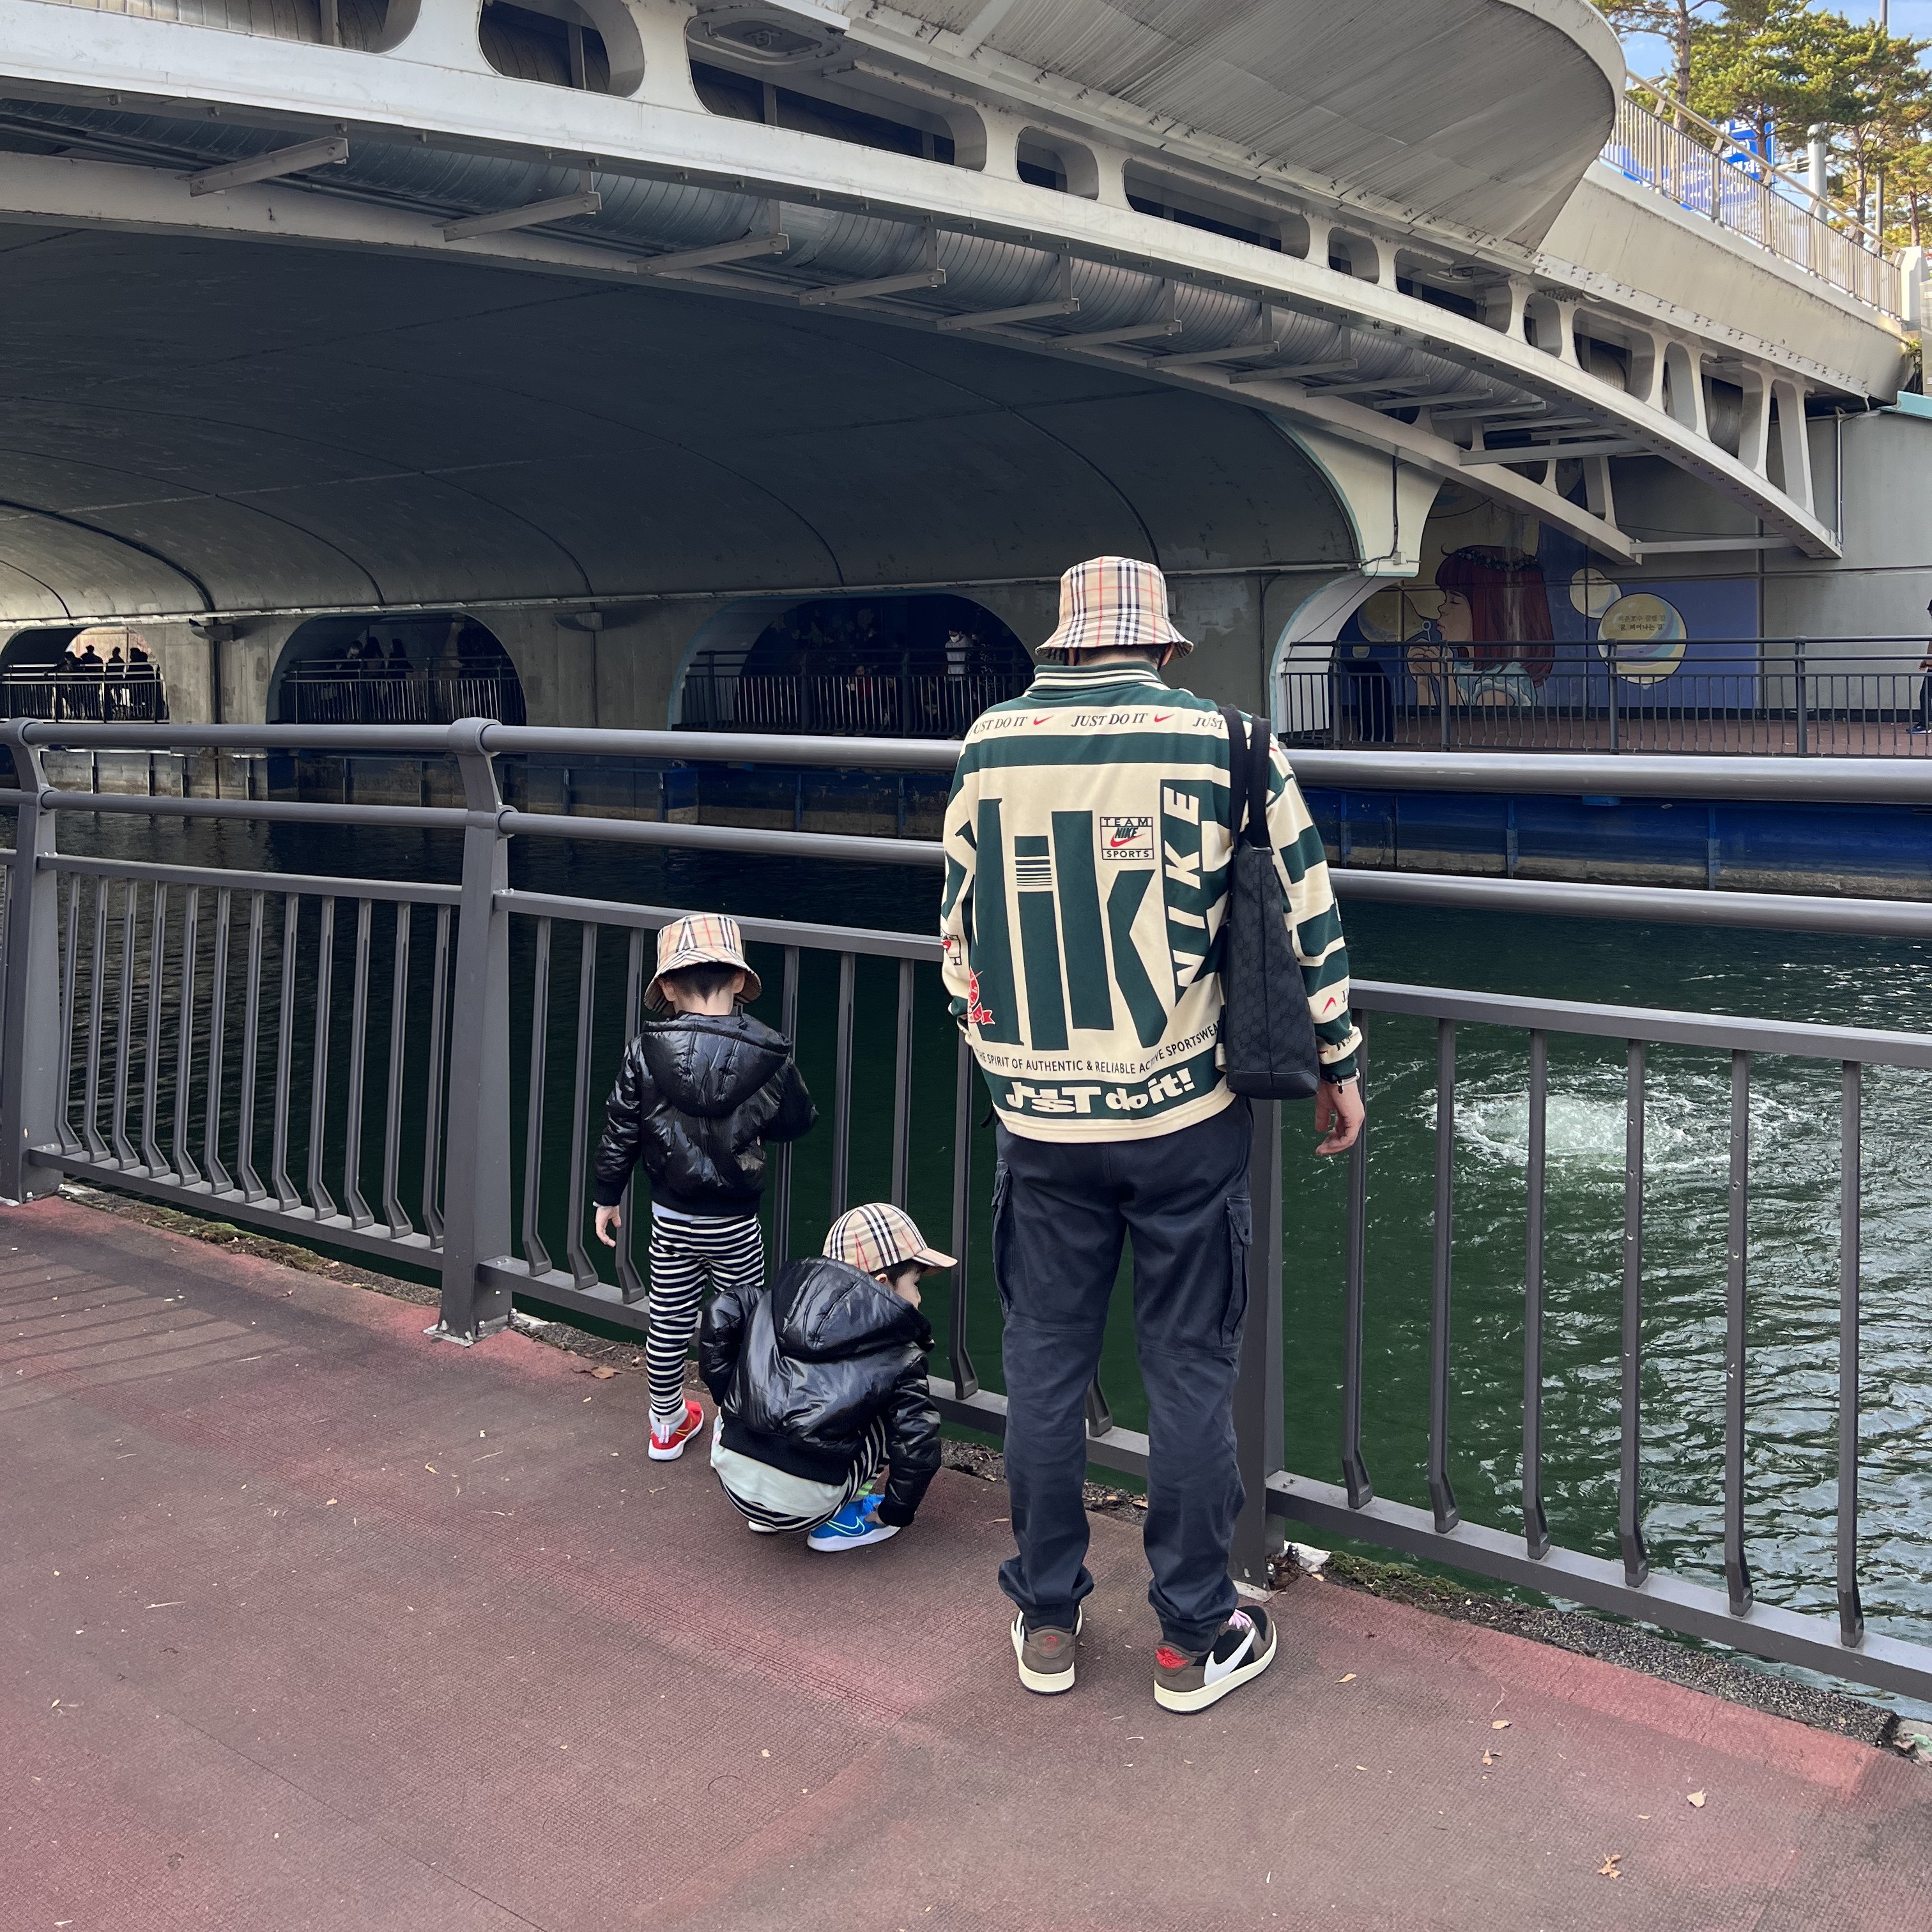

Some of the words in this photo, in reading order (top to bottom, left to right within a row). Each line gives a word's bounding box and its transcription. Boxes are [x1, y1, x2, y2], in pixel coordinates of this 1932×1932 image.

[994, 717, 1012, 729] DO
[1013, 716, 1028, 727] IT
[1071, 715, 1107, 728] JUST
[1108, 714, 1130, 725] DO
[1131, 713, 1149, 723] IT
[1192, 717, 1226, 730] JUST
[1103, 818, 1148, 827] TEAM
[1115, 826, 1139, 838] NIKE
[986, 1054, 1009, 1068] SPIRIT
[1011, 1059, 1023, 1070] OF
[1025, 1060, 1084, 1072] AUTHENTIC
[1087, 1061, 1093, 1071] &
[1095, 1061, 1136, 1074] RELIABLE
[1138, 1048, 1165, 1074] ACTIVE
[1165, 1021, 1220, 1057] SPORTSWEA
